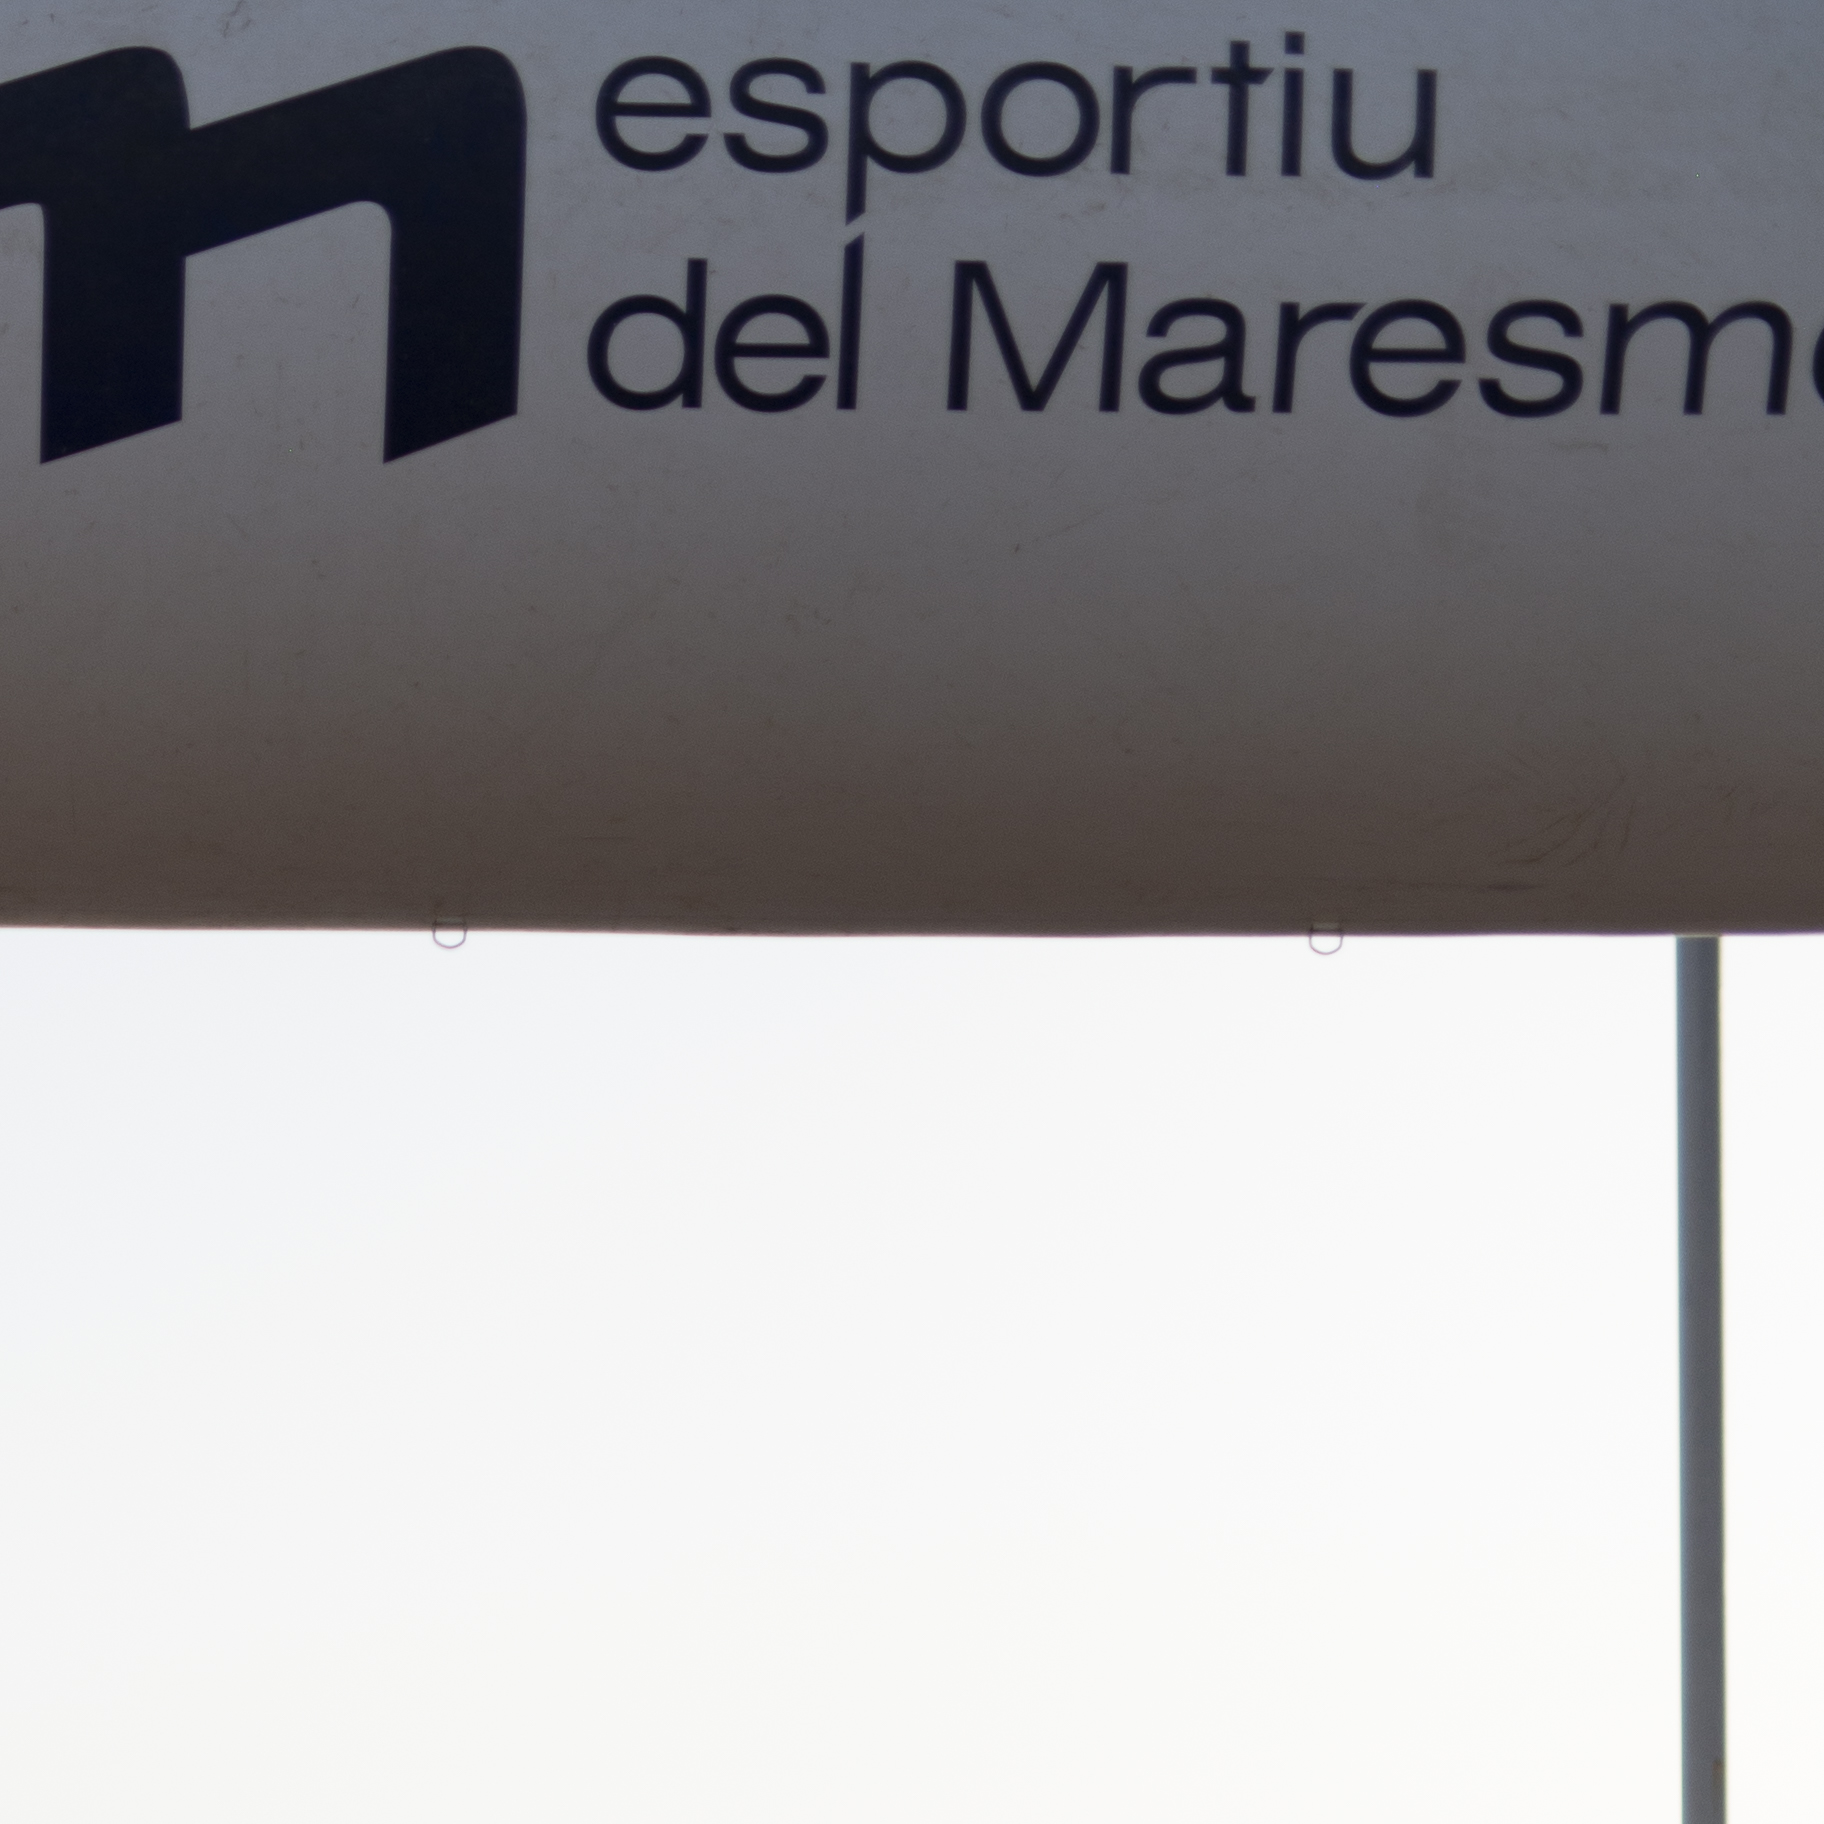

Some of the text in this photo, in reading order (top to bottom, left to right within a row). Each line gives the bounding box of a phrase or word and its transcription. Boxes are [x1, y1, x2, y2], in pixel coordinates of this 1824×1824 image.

[594, 30, 1439, 226] esportiu
[586, 230, 1824, 421] del Maresm
